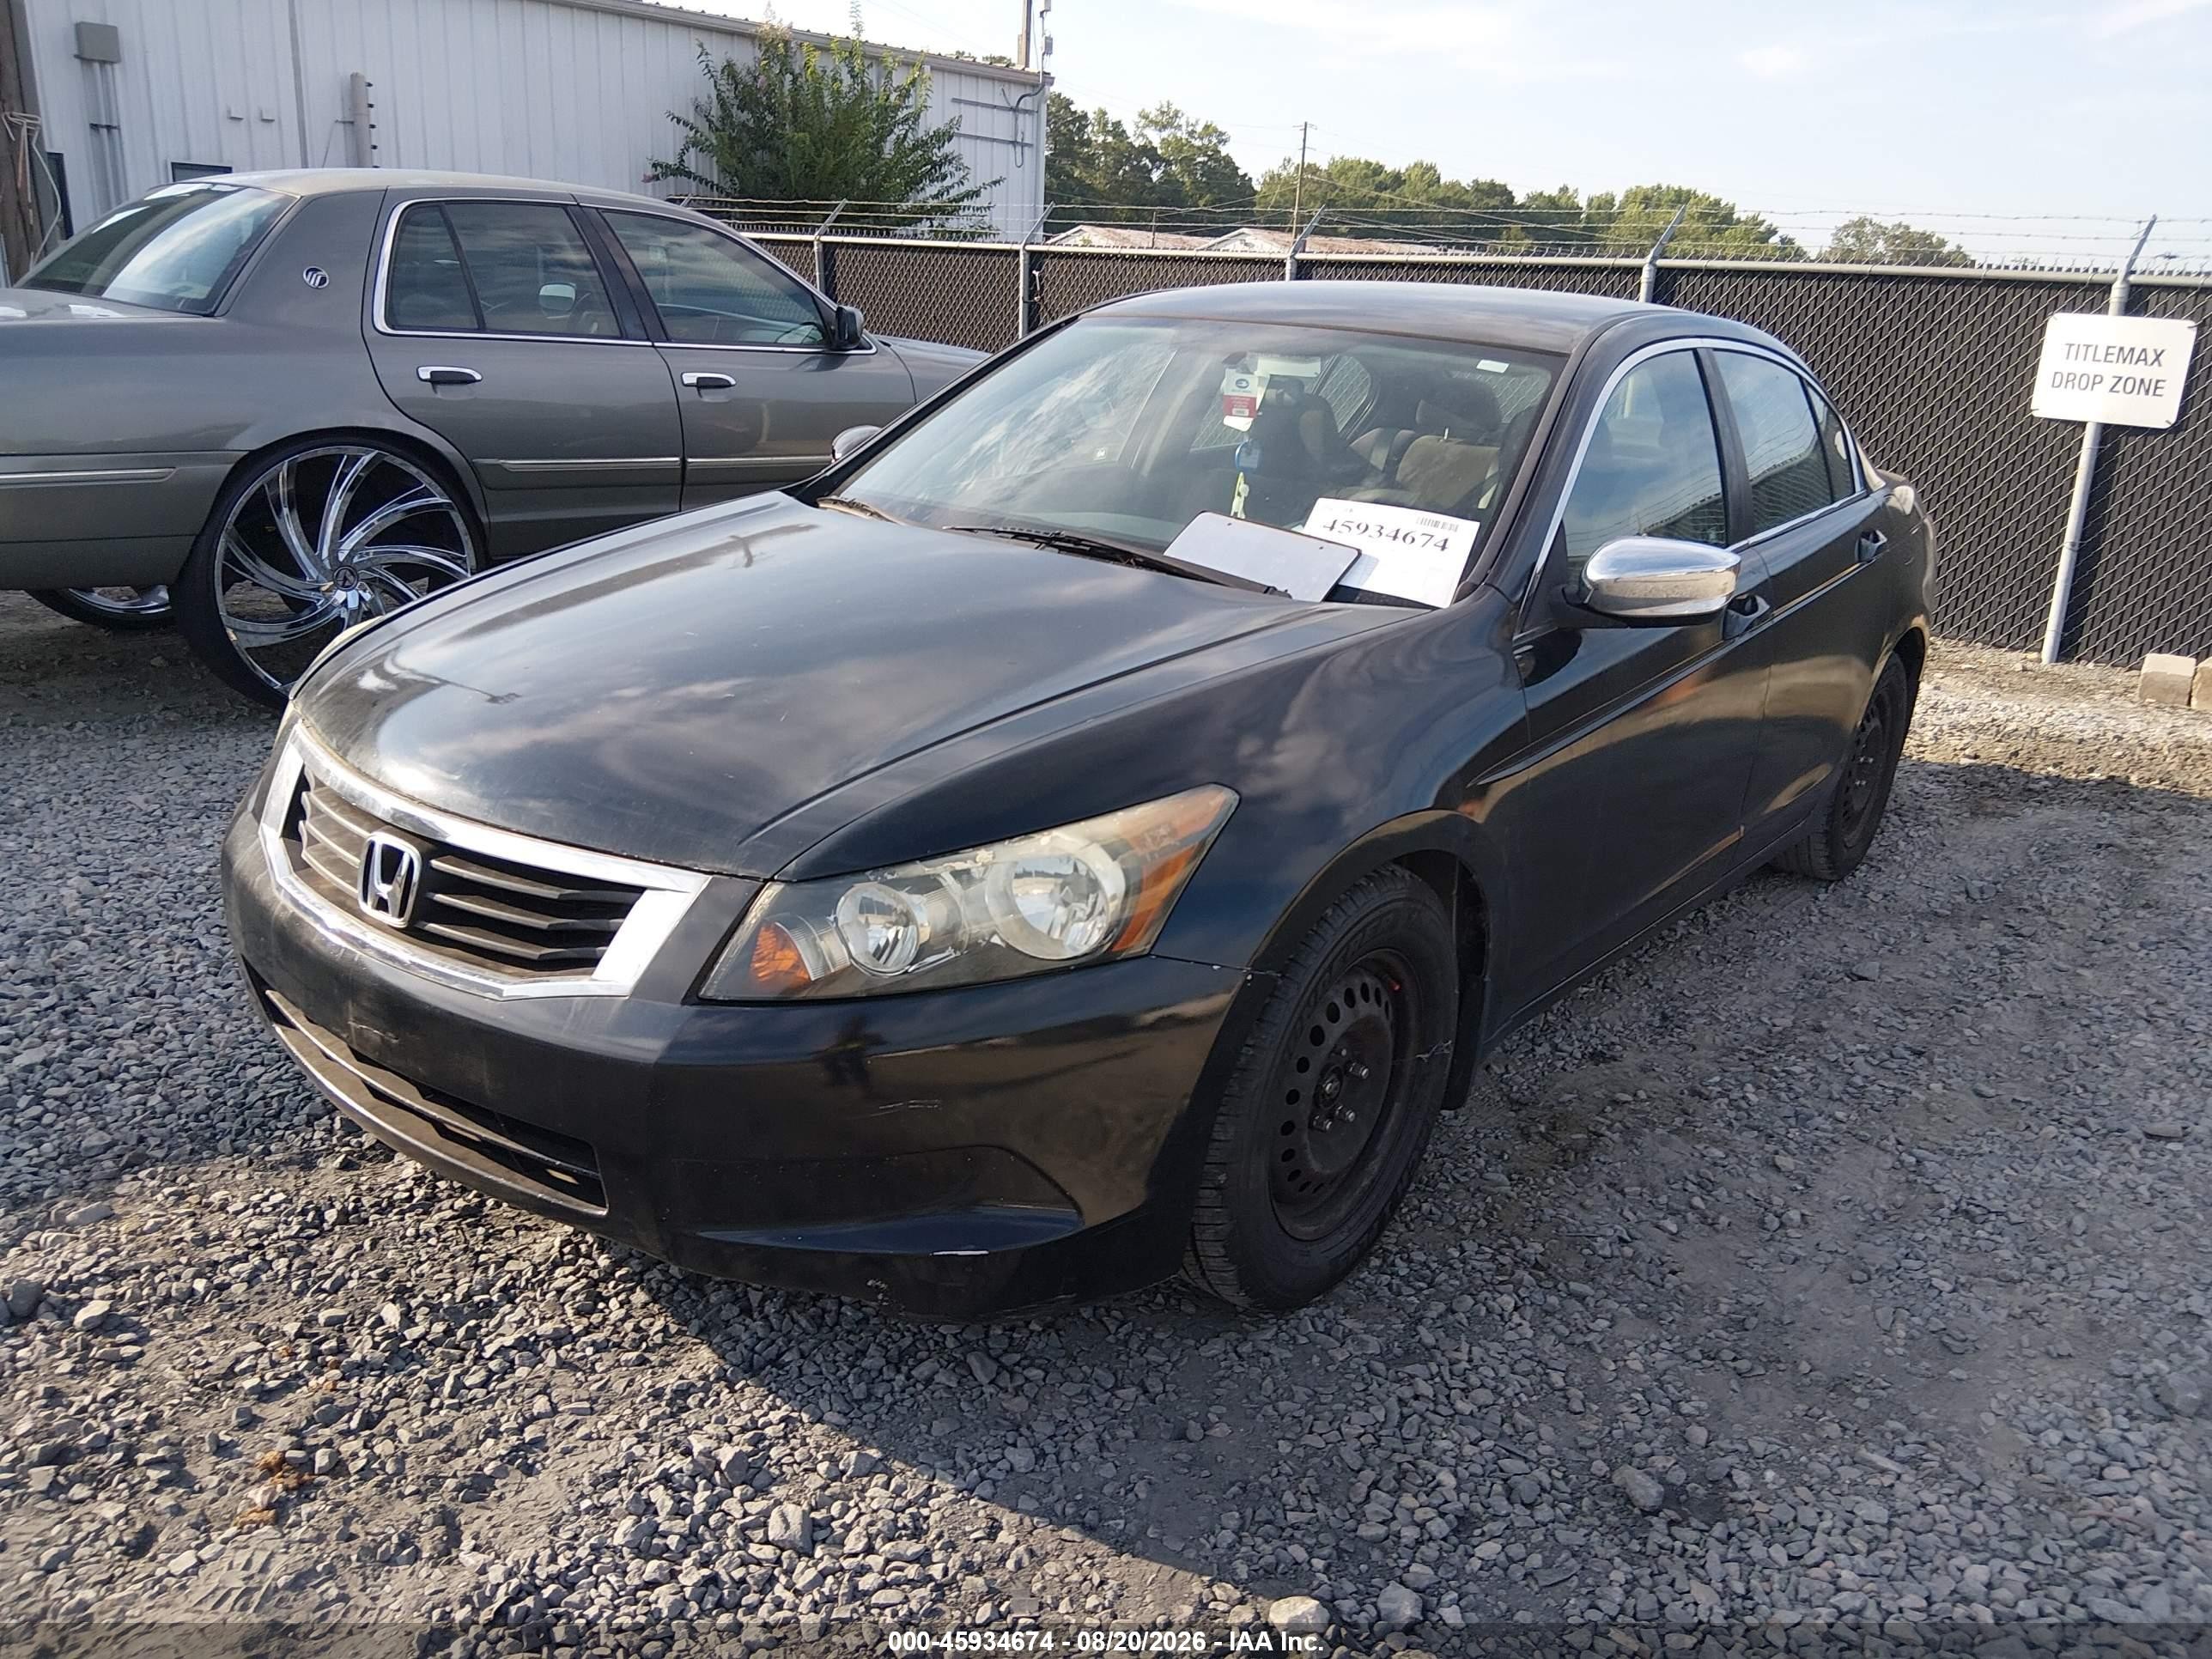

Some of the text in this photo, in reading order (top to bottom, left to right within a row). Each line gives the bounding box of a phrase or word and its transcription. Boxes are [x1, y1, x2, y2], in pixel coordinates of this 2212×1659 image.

[2064, 343, 2167, 368] TITLEMAX
[2051, 371, 2167, 398] DROP ZONE
[1322, 518, 1449, 552] 45934674
